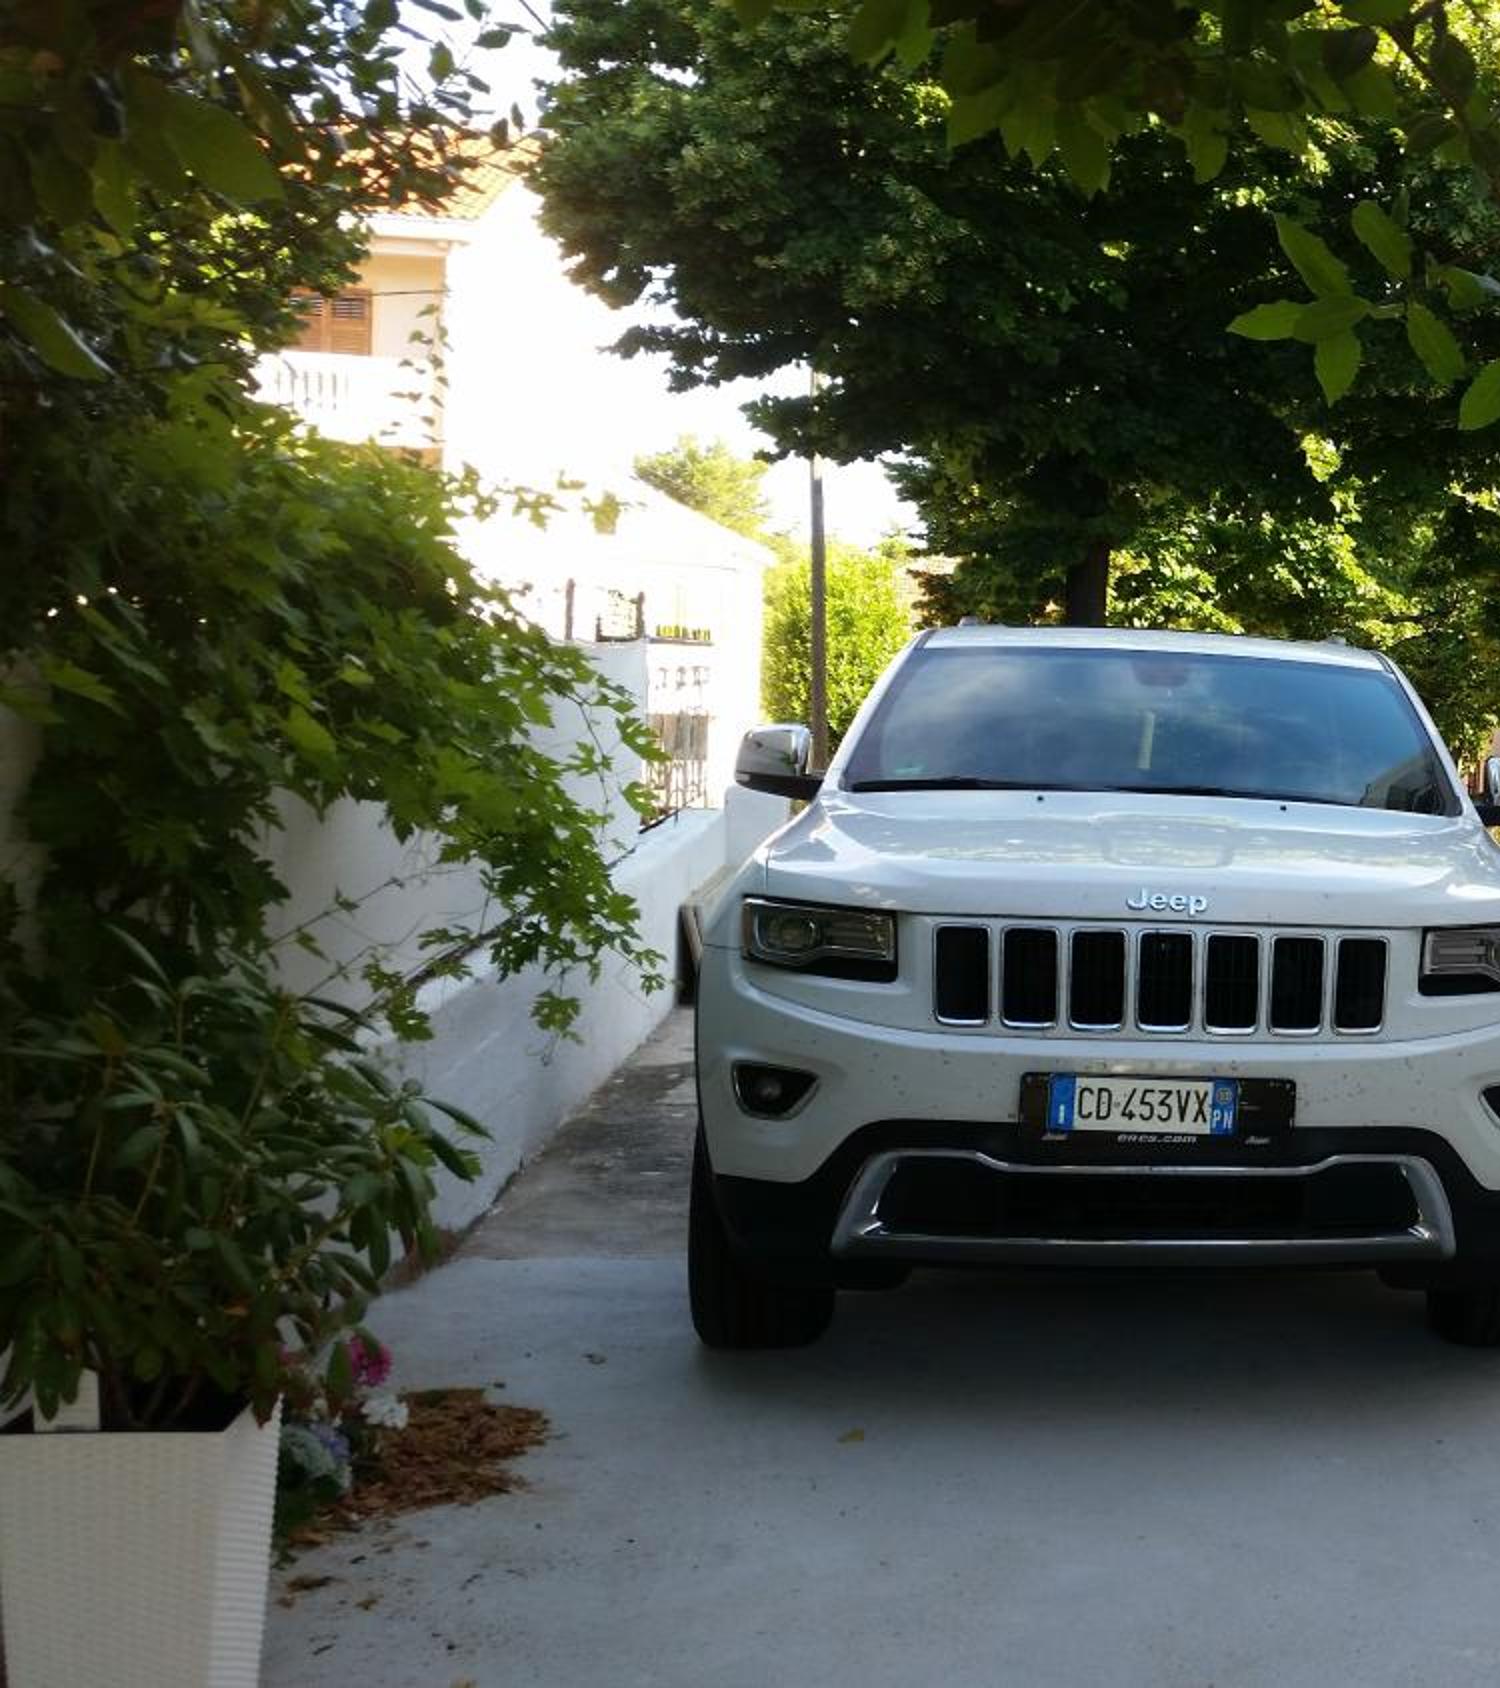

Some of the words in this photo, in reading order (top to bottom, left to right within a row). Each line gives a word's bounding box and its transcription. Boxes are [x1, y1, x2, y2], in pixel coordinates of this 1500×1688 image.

[1126, 887, 1208, 918] Jeep
[1121, 1087, 1209, 1123] 453VX
[1211, 1109, 1233, 1128] PN
